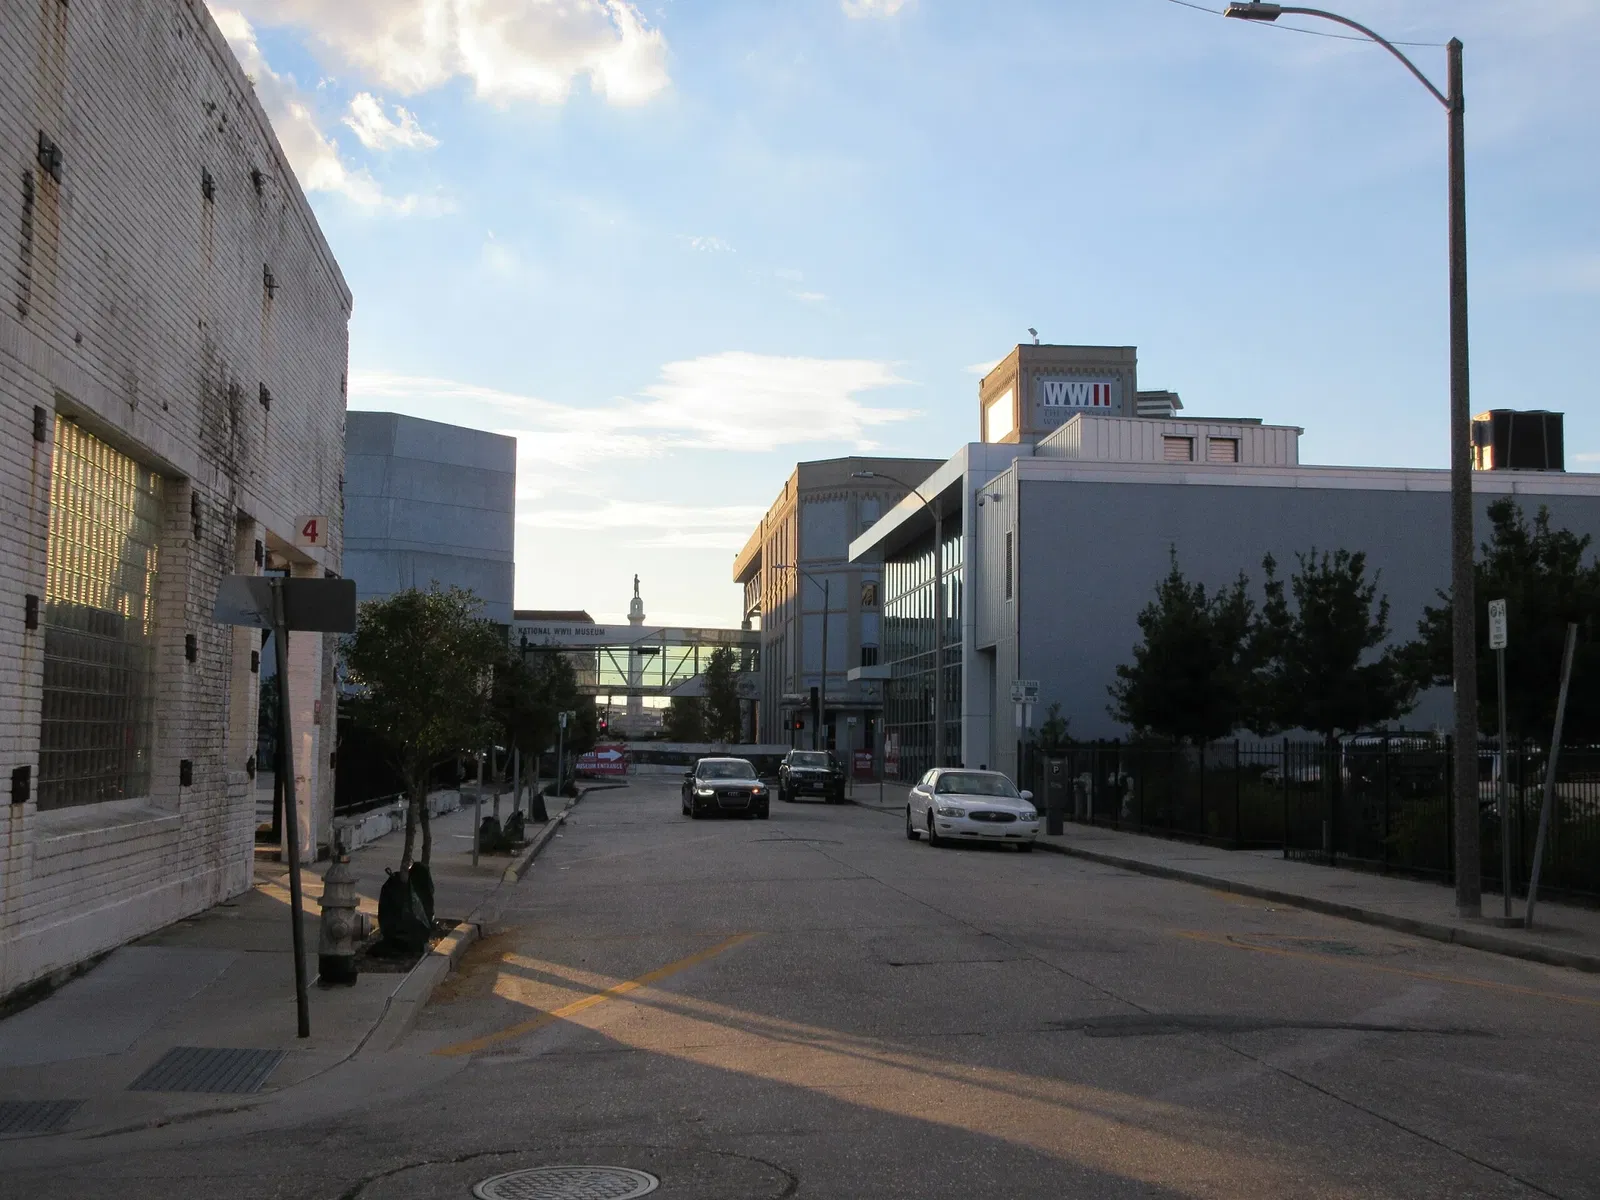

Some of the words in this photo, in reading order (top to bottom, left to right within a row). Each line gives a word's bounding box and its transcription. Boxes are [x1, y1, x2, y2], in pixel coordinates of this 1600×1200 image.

[1044, 382, 1111, 407] WWII
[302, 519, 318, 543] 4
[518, 627, 551, 635] NATIONAL
[554, 627, 572, 635] WWII
[575, 628, 606, 636] MUSEUM
